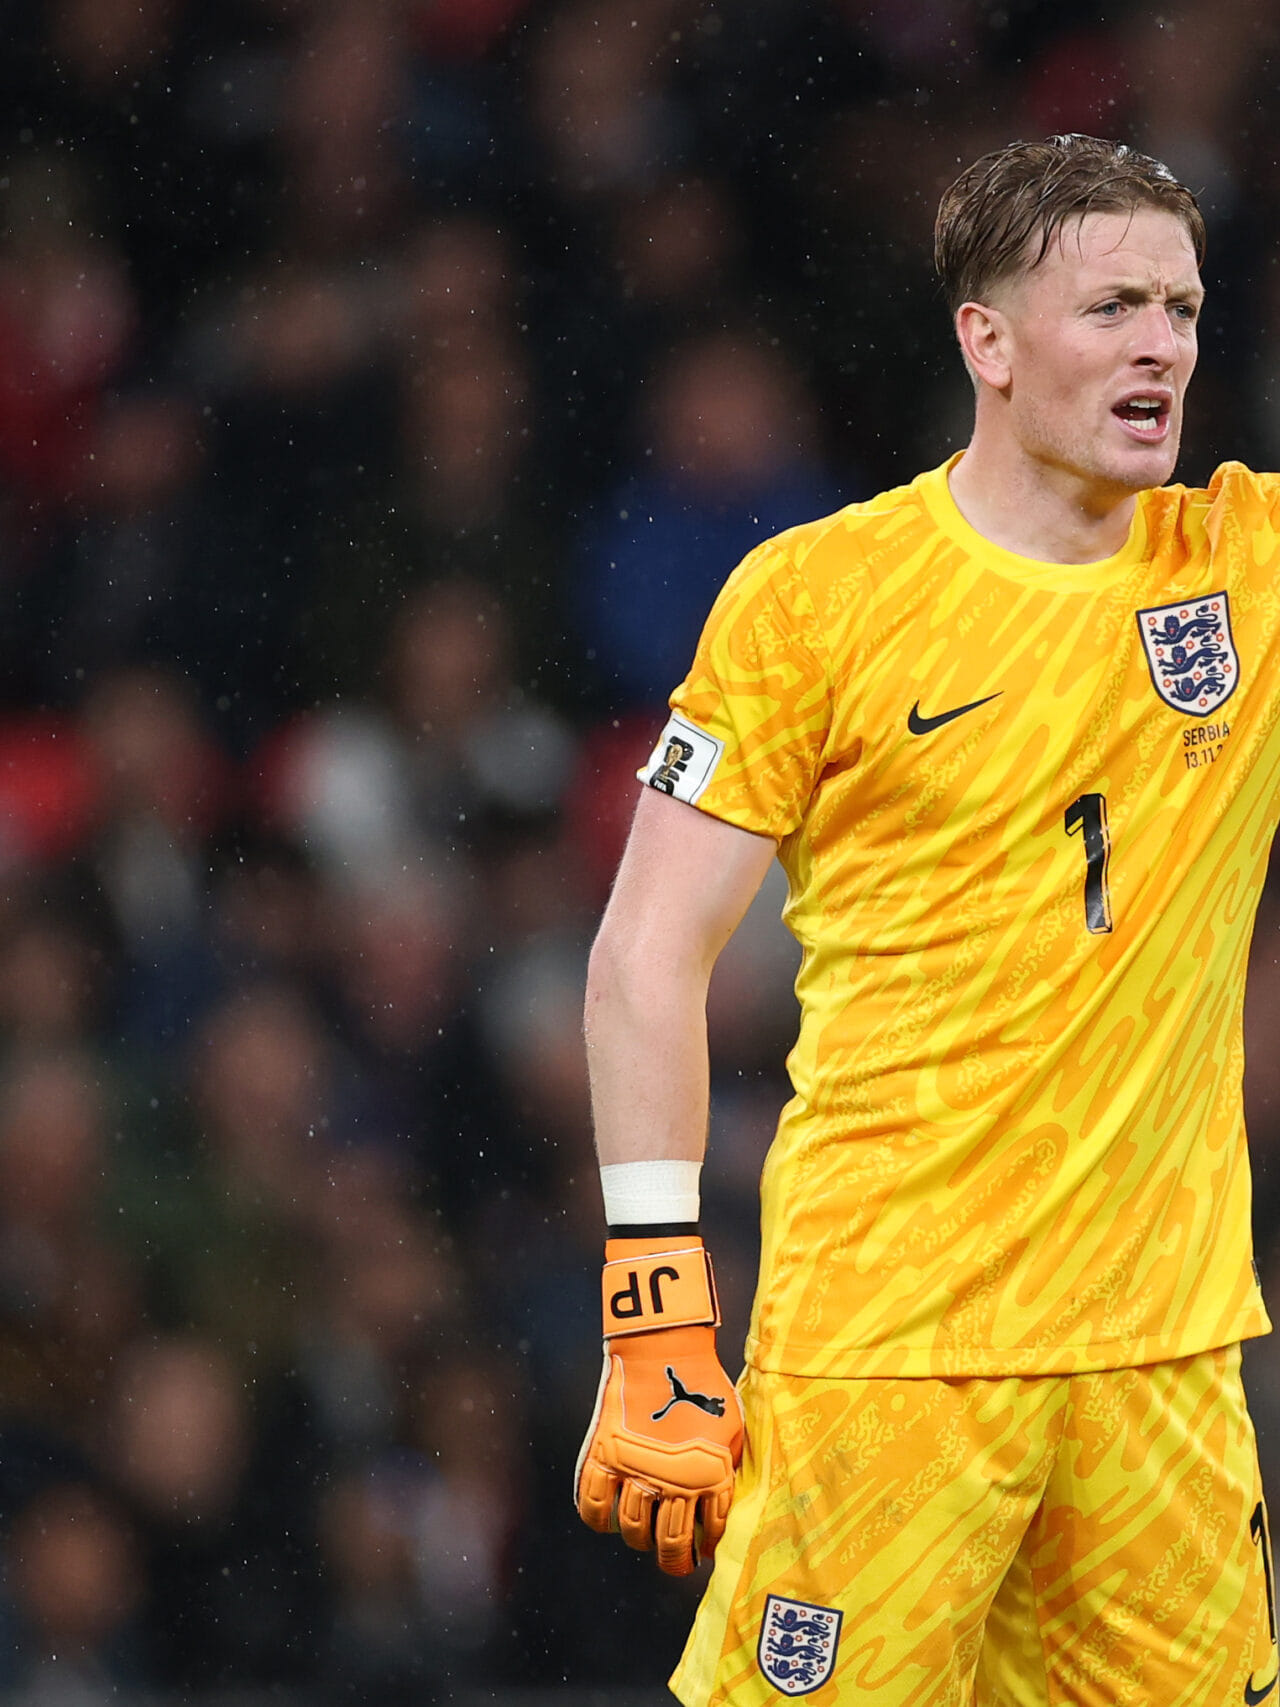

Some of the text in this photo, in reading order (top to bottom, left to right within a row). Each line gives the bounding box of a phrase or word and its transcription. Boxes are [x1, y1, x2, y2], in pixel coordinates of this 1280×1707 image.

[1183, 721, 1230, 747] SERBIA
[1065, 793, 1112, 934] 1
[611, 1266, 680, 1319] JP
[1250, 1501, 1277, 1645] 1
